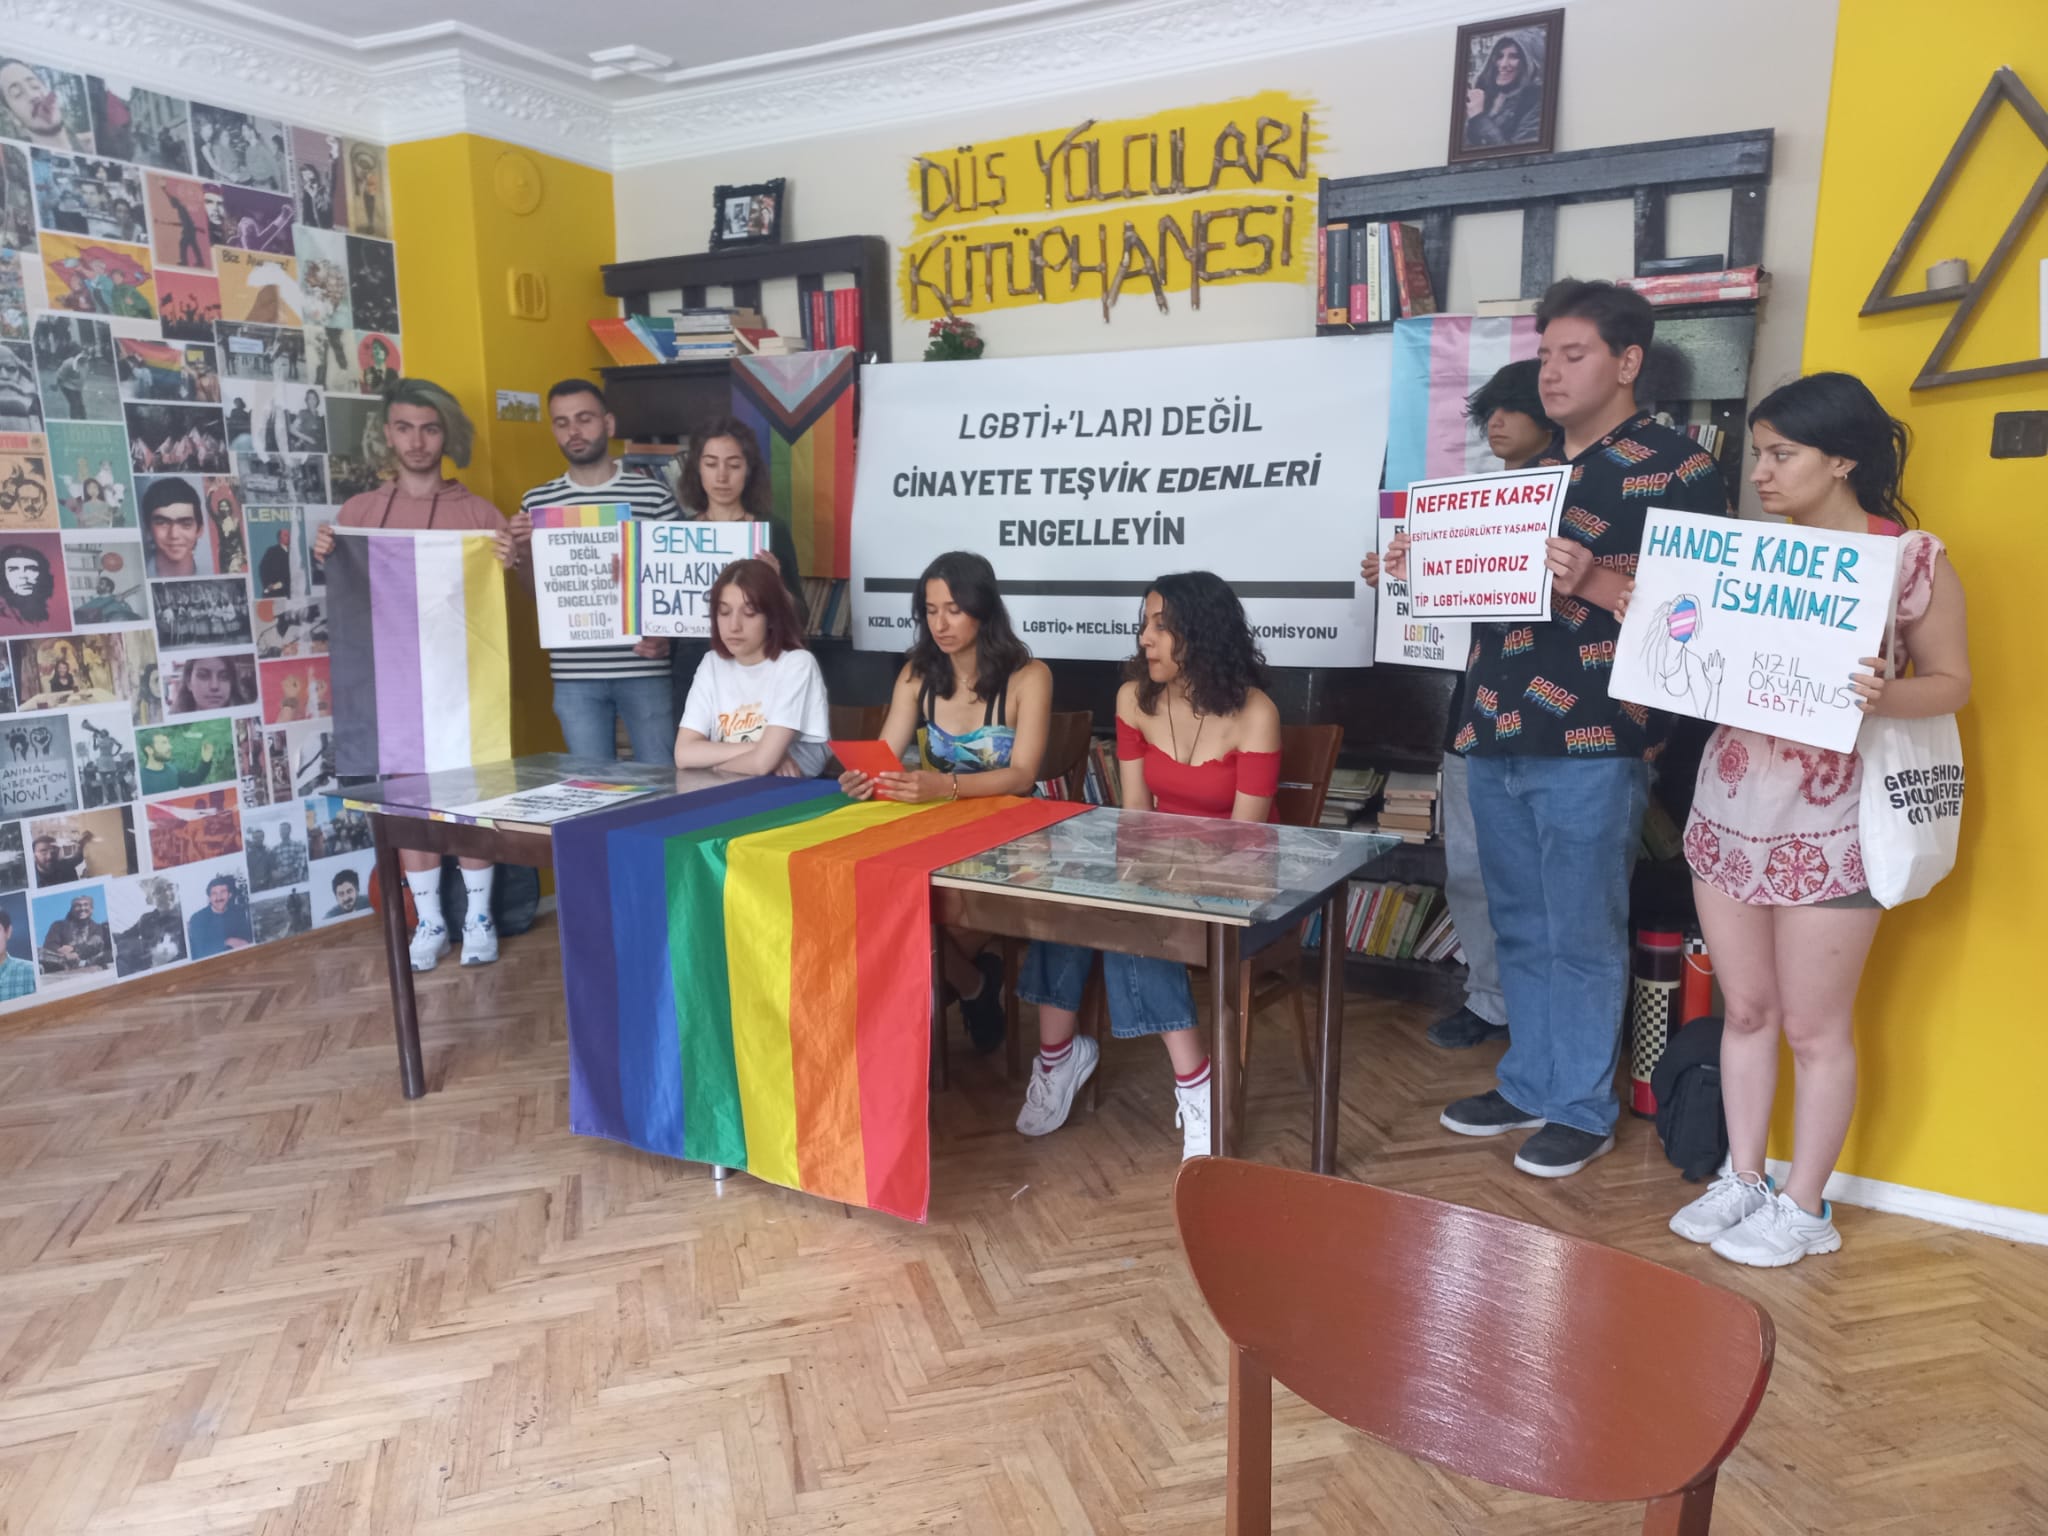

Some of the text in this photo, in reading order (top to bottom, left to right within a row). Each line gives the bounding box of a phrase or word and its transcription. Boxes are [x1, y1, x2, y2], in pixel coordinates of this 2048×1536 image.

[914, 113, 1309, 221] DÜŞ YOLCULARI
[909, 195, 1295, 323] KÜTÜPHANESİ
[1162, 394, 1263, 437] DEĞİL
[892, 452, 1323, 500] CİNAYETE TEŞVİK EDENLERİ
[1415, 483, 1554, 514] NEFRETE KARŞI
[547, 527, 619, 546] FESTİVALLERİ
[652, 526, 733, 554] GENEL
[998, 509, 1187, 548] ENGELLEYİN
[1412, 525, 1448, 542] EŞİTLİKTE
[1449, 523, 1502, 539] ÖZGÜRLÜKTE
[1504, 521, 1548, 536] YAŞAMDA
[569, 545, 601, 561] DEĞİL
[1422, 553, 1530, 577] İNAT EDİYORUZ
[1647, 525, 1860, 584] HANDE KADER
[543, 577, 590, 593] YÖNELİK
[1415, 592, 1430, 608] TİP
[1711, 571, 1862, 632] İSYANIMIZ
[868, 615, 895, 629] KIZIL
[1022, 619, 1074, 634] LGBTİQ+
[1075, 620, 1139, 636] MECLİSLE
[1253, 622, 1339, 640] KOMİSYONU
[1403, 623, 1445, 646] LGBTİQ+
[1752, 651, 1811, 680] KIZIL
[1525, 675, 1580, 715] PRIDE
[1747, 670, 1851, 710] OKYANUS
[1565, 725, 1617, 751] PRIDE
[3, 784, 50, 806] NOW!
